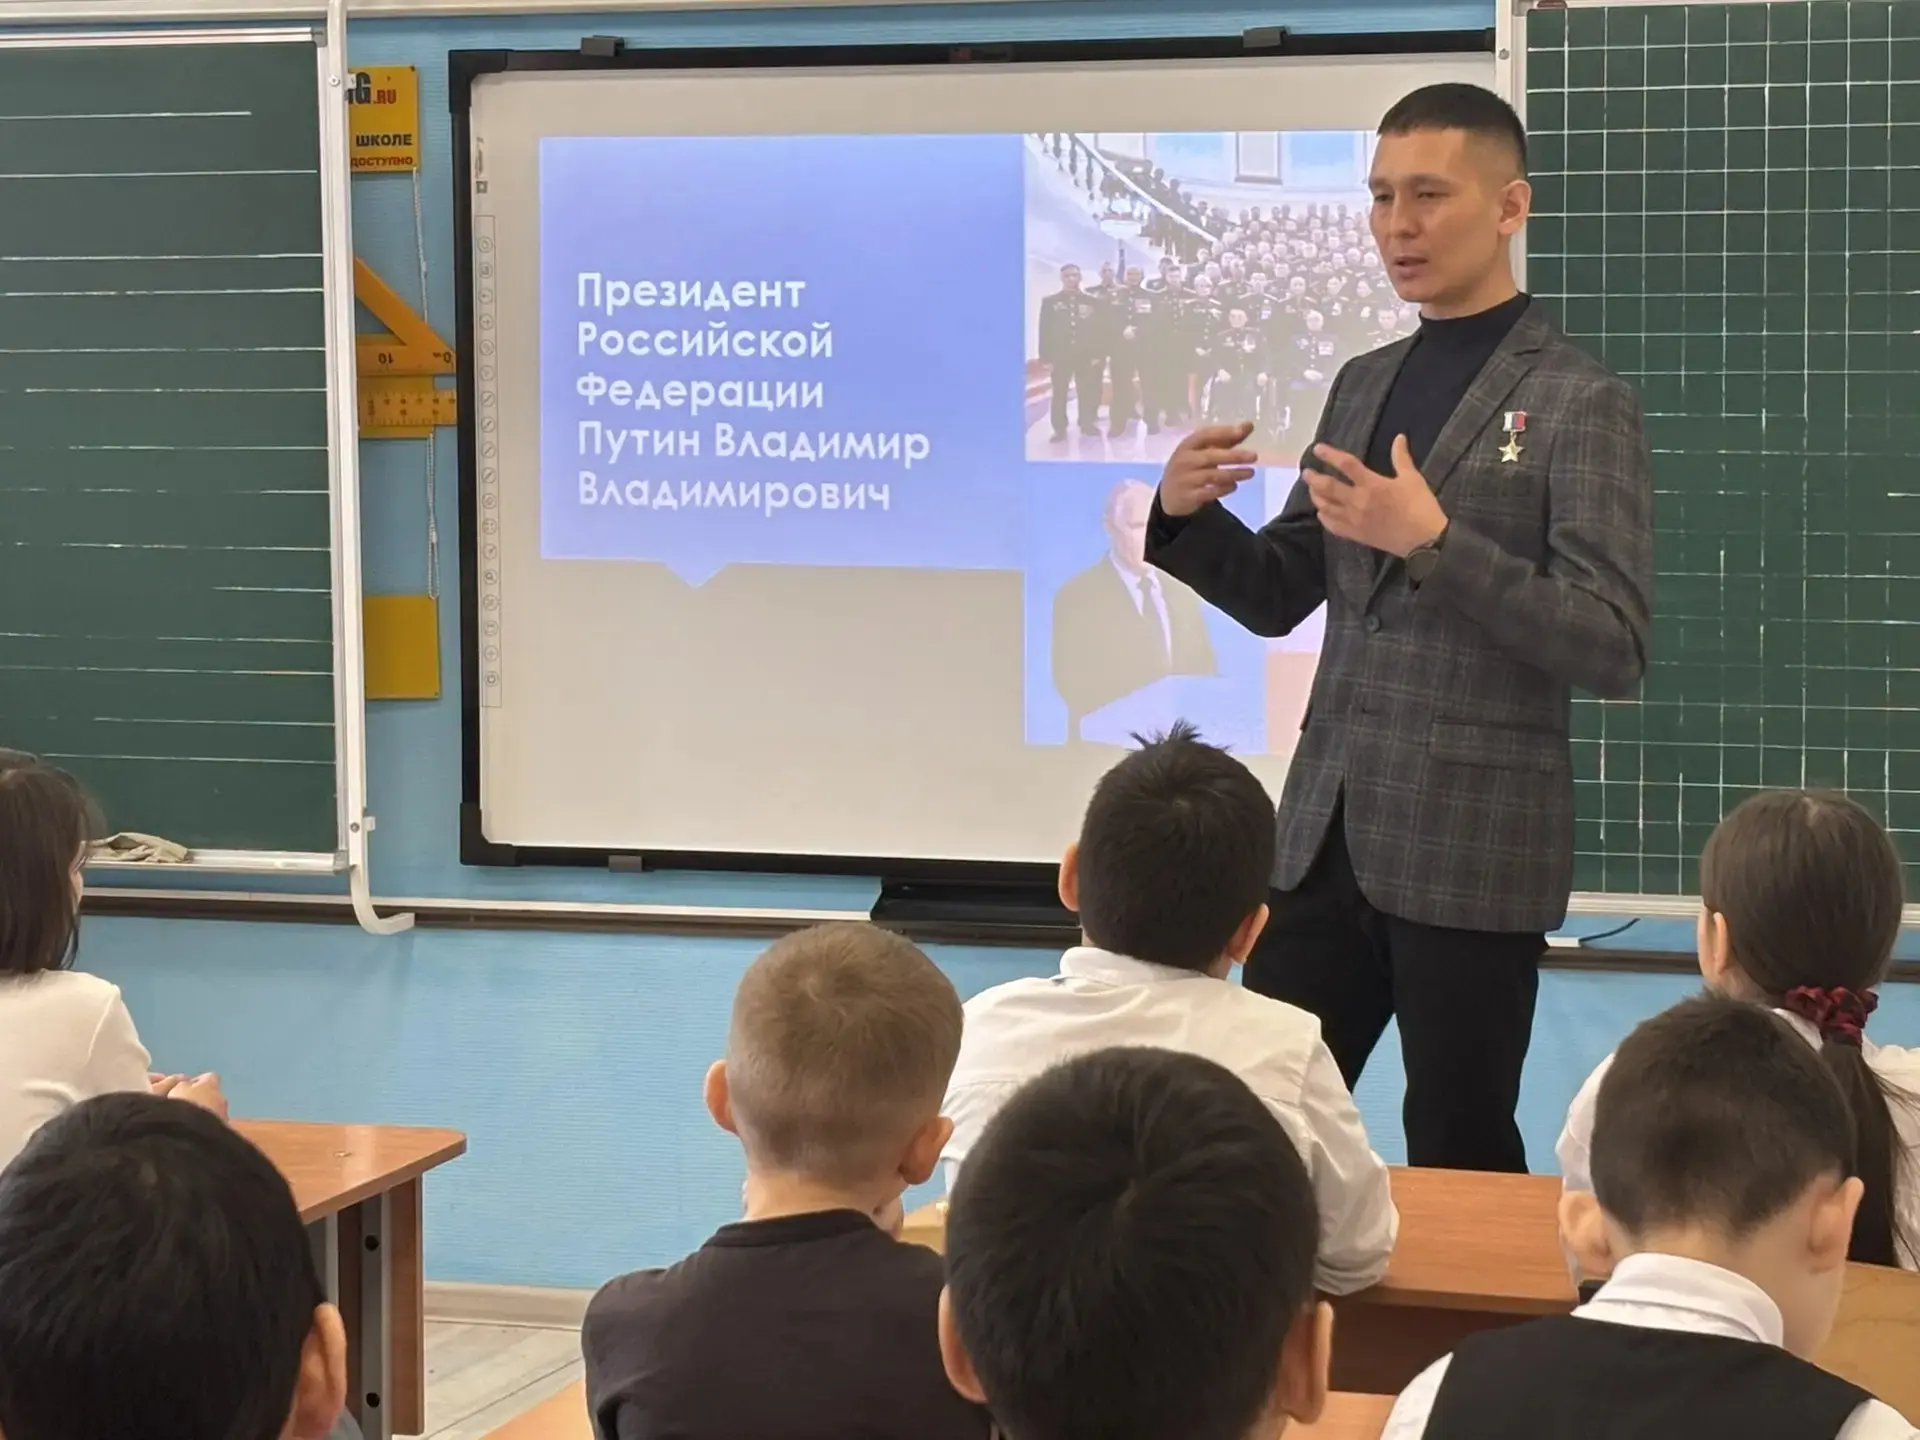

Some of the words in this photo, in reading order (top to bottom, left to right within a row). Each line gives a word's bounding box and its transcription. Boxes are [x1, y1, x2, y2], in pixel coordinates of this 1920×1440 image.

[355, 134, 412, 147] ШКОЛЕ
[350, 156, 413, 168] ДОСТУПНО
[578, 272, 806, 316] Президент
[378, 353, 394, 364] 10
[579, 321, 832, 357] Российской
[577, 372, 823, 415] Федерации
[579, 421, 699, 464] Путин
[716, 423, 929, 469] Владимир
[580, 471, 889, 517] Владимирович
